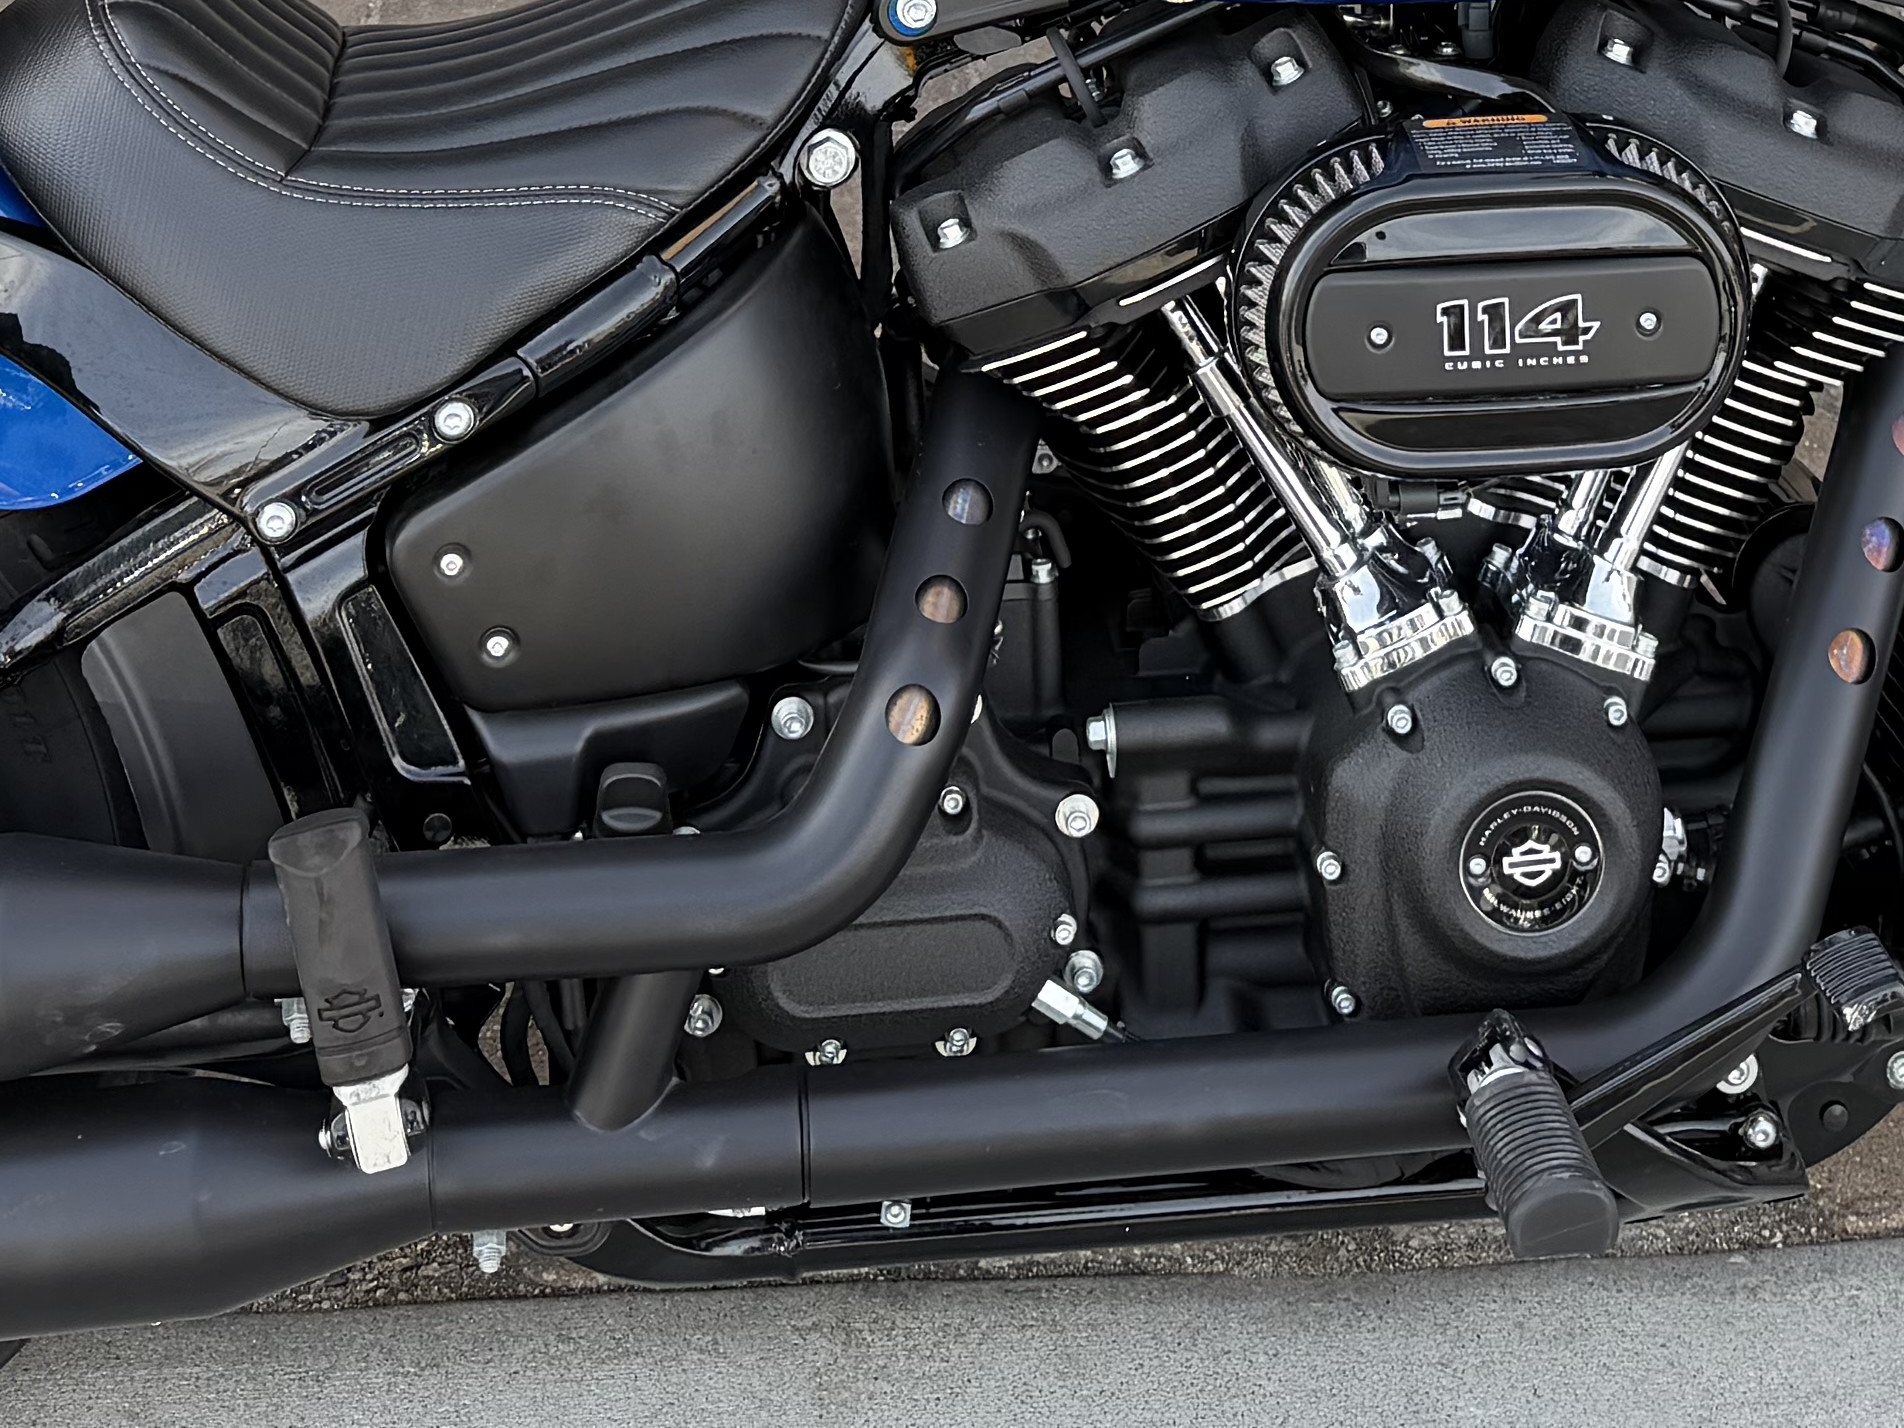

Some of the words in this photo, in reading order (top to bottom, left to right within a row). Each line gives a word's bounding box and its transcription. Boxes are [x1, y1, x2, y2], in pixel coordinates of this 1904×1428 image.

[1436, 293, 1601, 357] 114
[1444, 359, 1506, 372] CUBIC
[1517, 354, 1590, 368] INCHES
